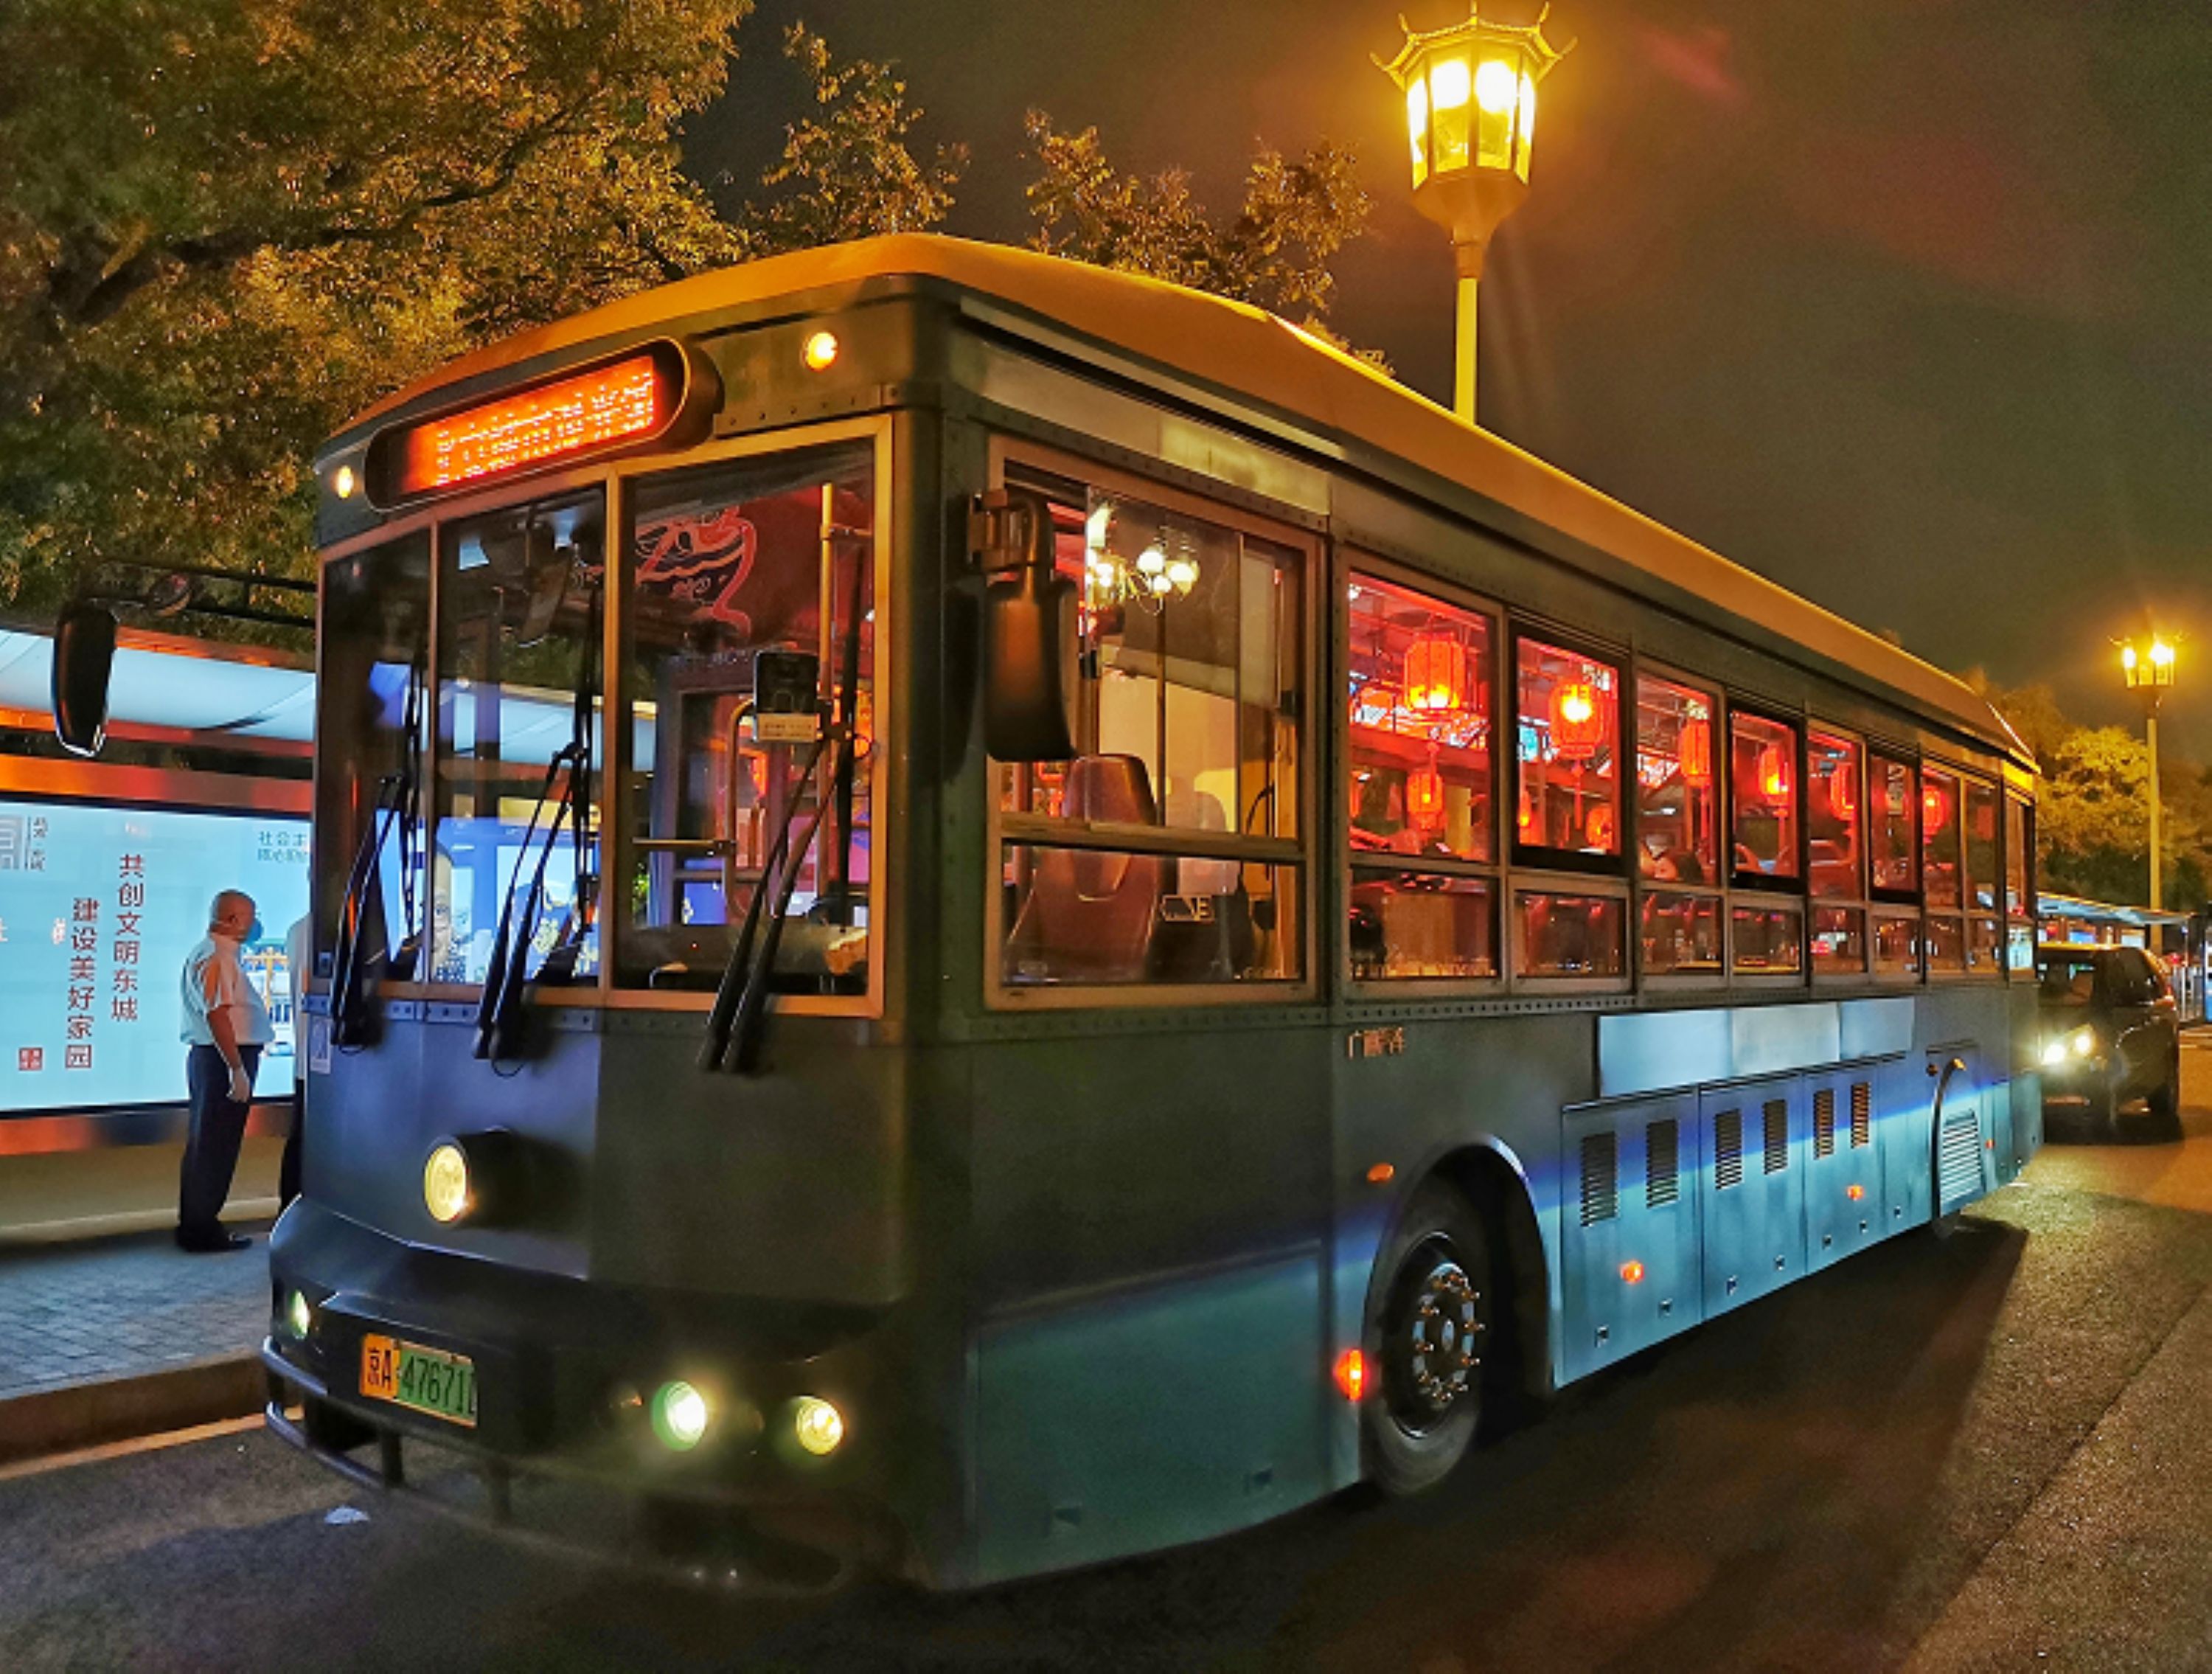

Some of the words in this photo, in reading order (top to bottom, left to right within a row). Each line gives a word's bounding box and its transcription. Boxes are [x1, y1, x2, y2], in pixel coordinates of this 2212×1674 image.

[65, 897, 100, 1069] 建设美好家园
[111, 853, 145, 1022] 共创文明东城
